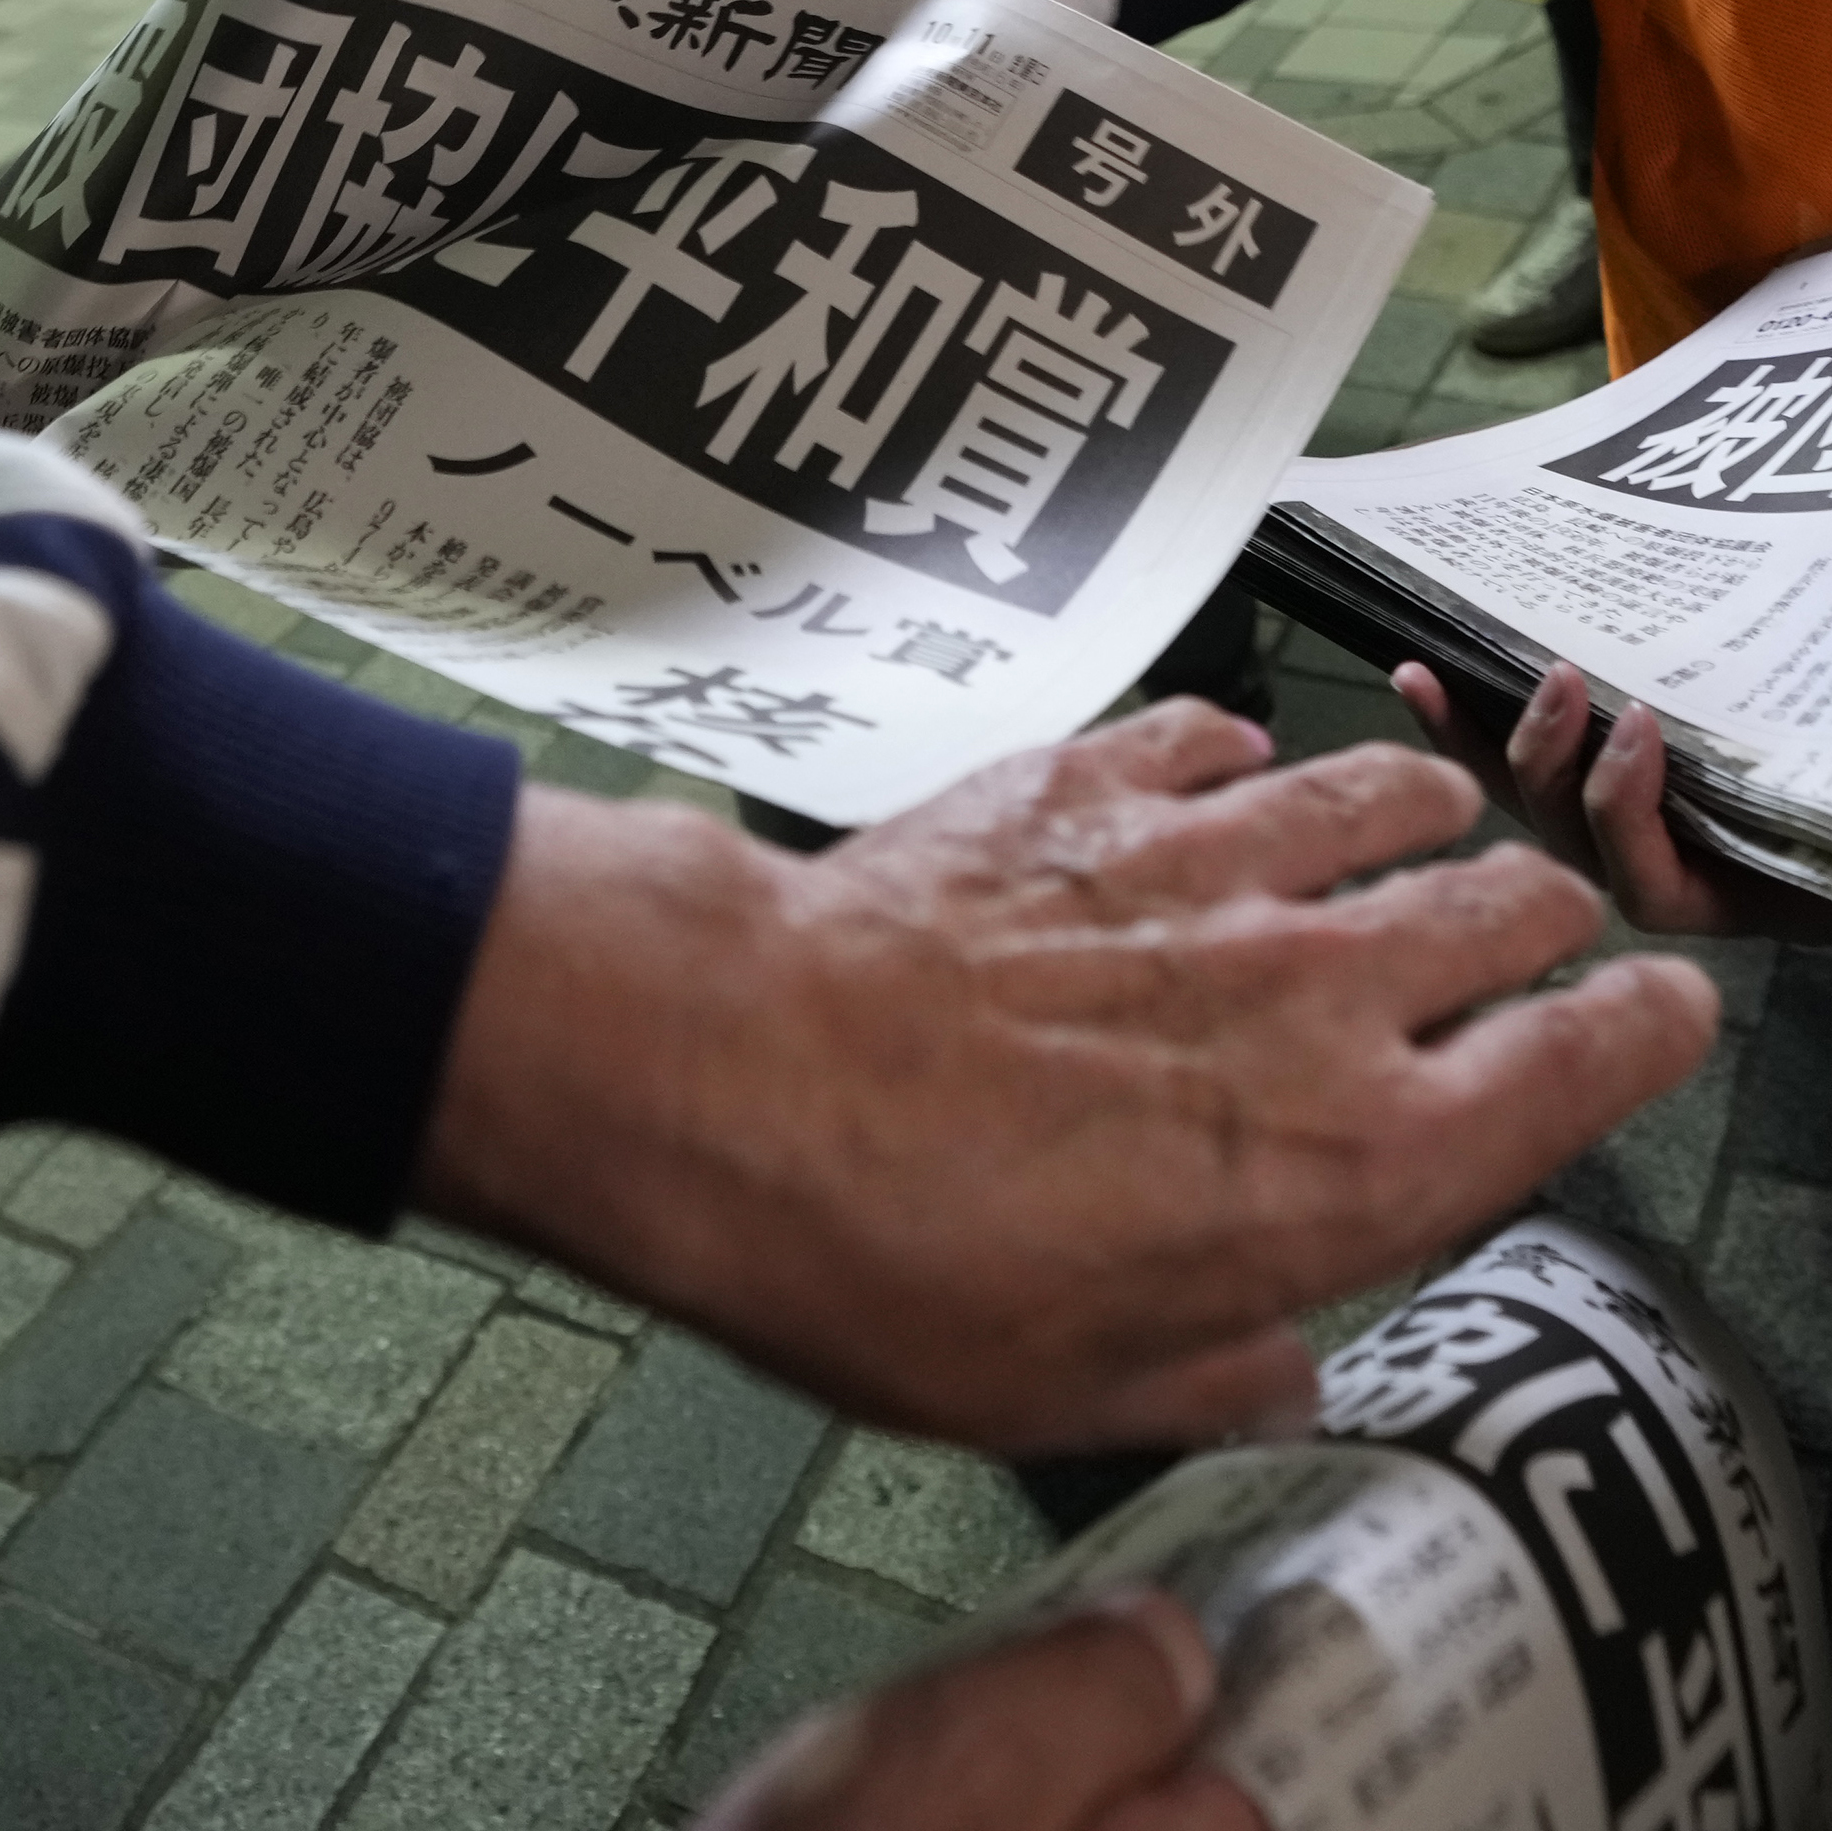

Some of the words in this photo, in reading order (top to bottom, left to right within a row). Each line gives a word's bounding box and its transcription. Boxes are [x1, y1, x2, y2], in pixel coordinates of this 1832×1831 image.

[1070, 122, 1263, 276] 号外
[427, 442, 1015, 689] ノーベル賞
